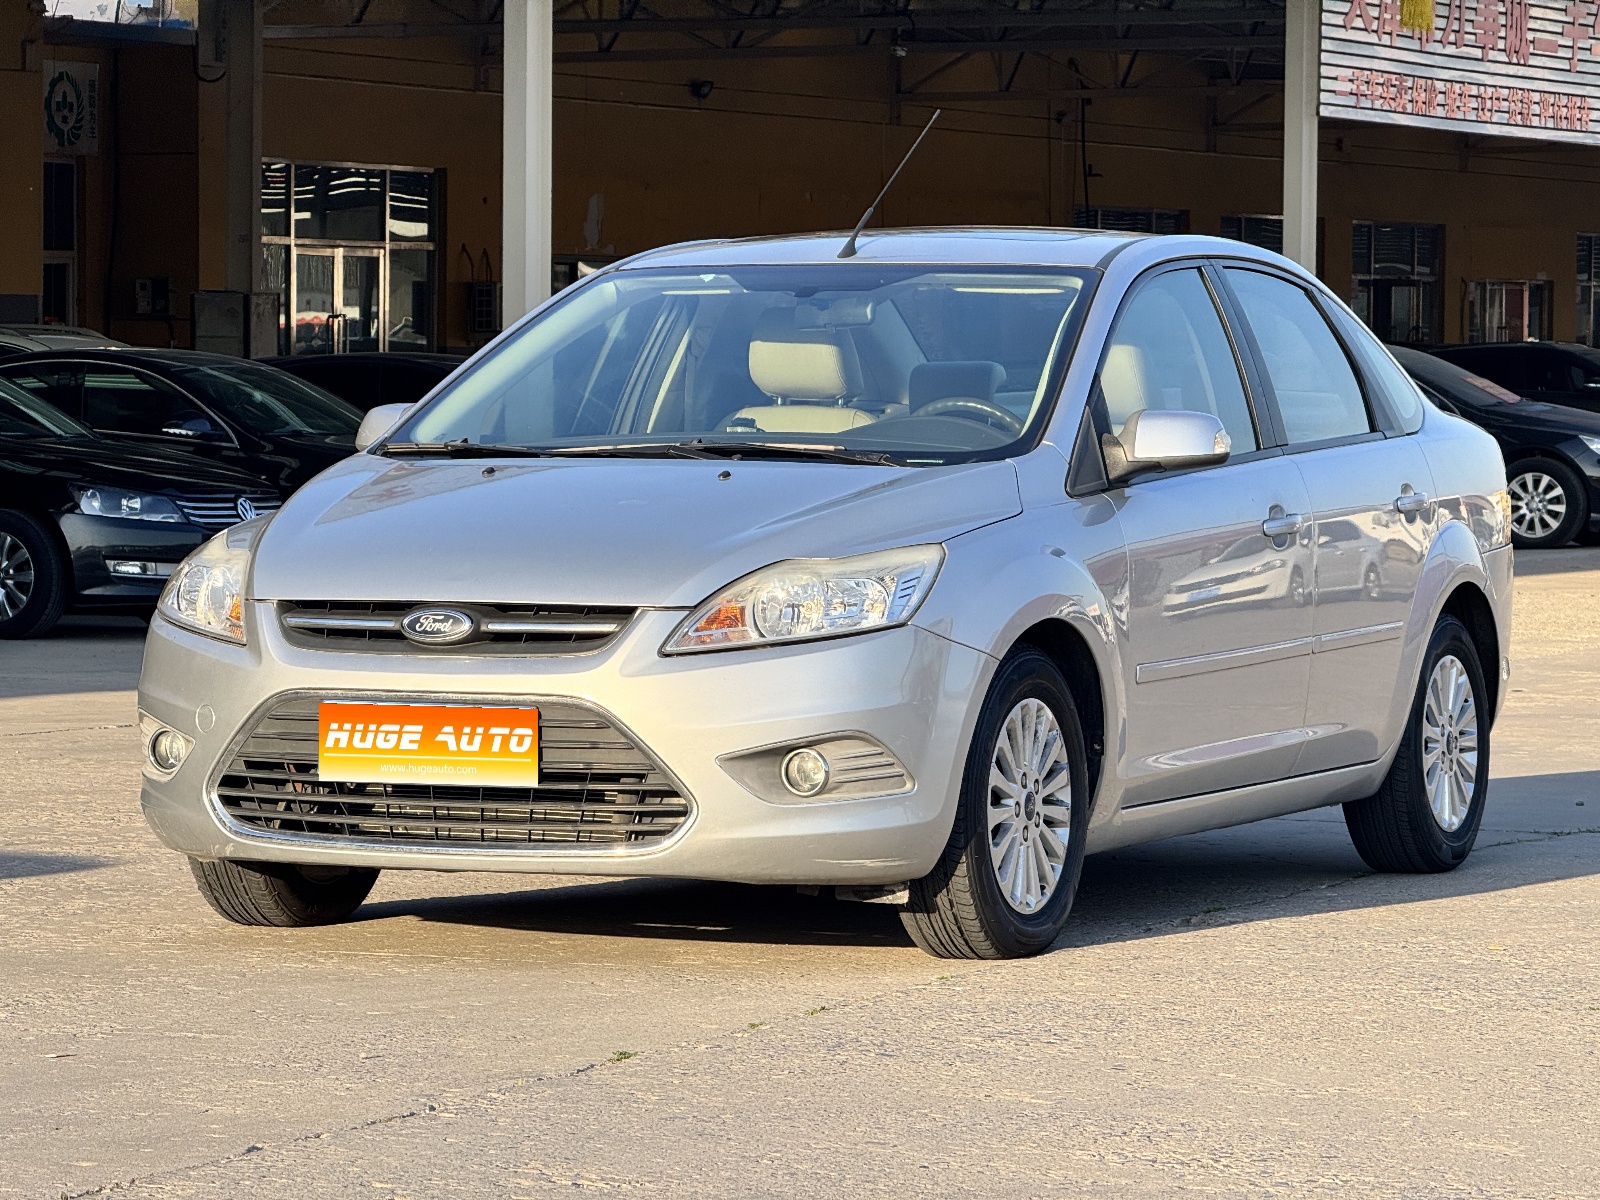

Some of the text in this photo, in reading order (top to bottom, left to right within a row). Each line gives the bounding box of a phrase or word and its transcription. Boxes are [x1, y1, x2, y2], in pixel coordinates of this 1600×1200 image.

[1335, 70, 1408, 113] 二手车买卖
[1477, 86, 1503, 122] 过户
[415, 614, 453, 633] Ford
